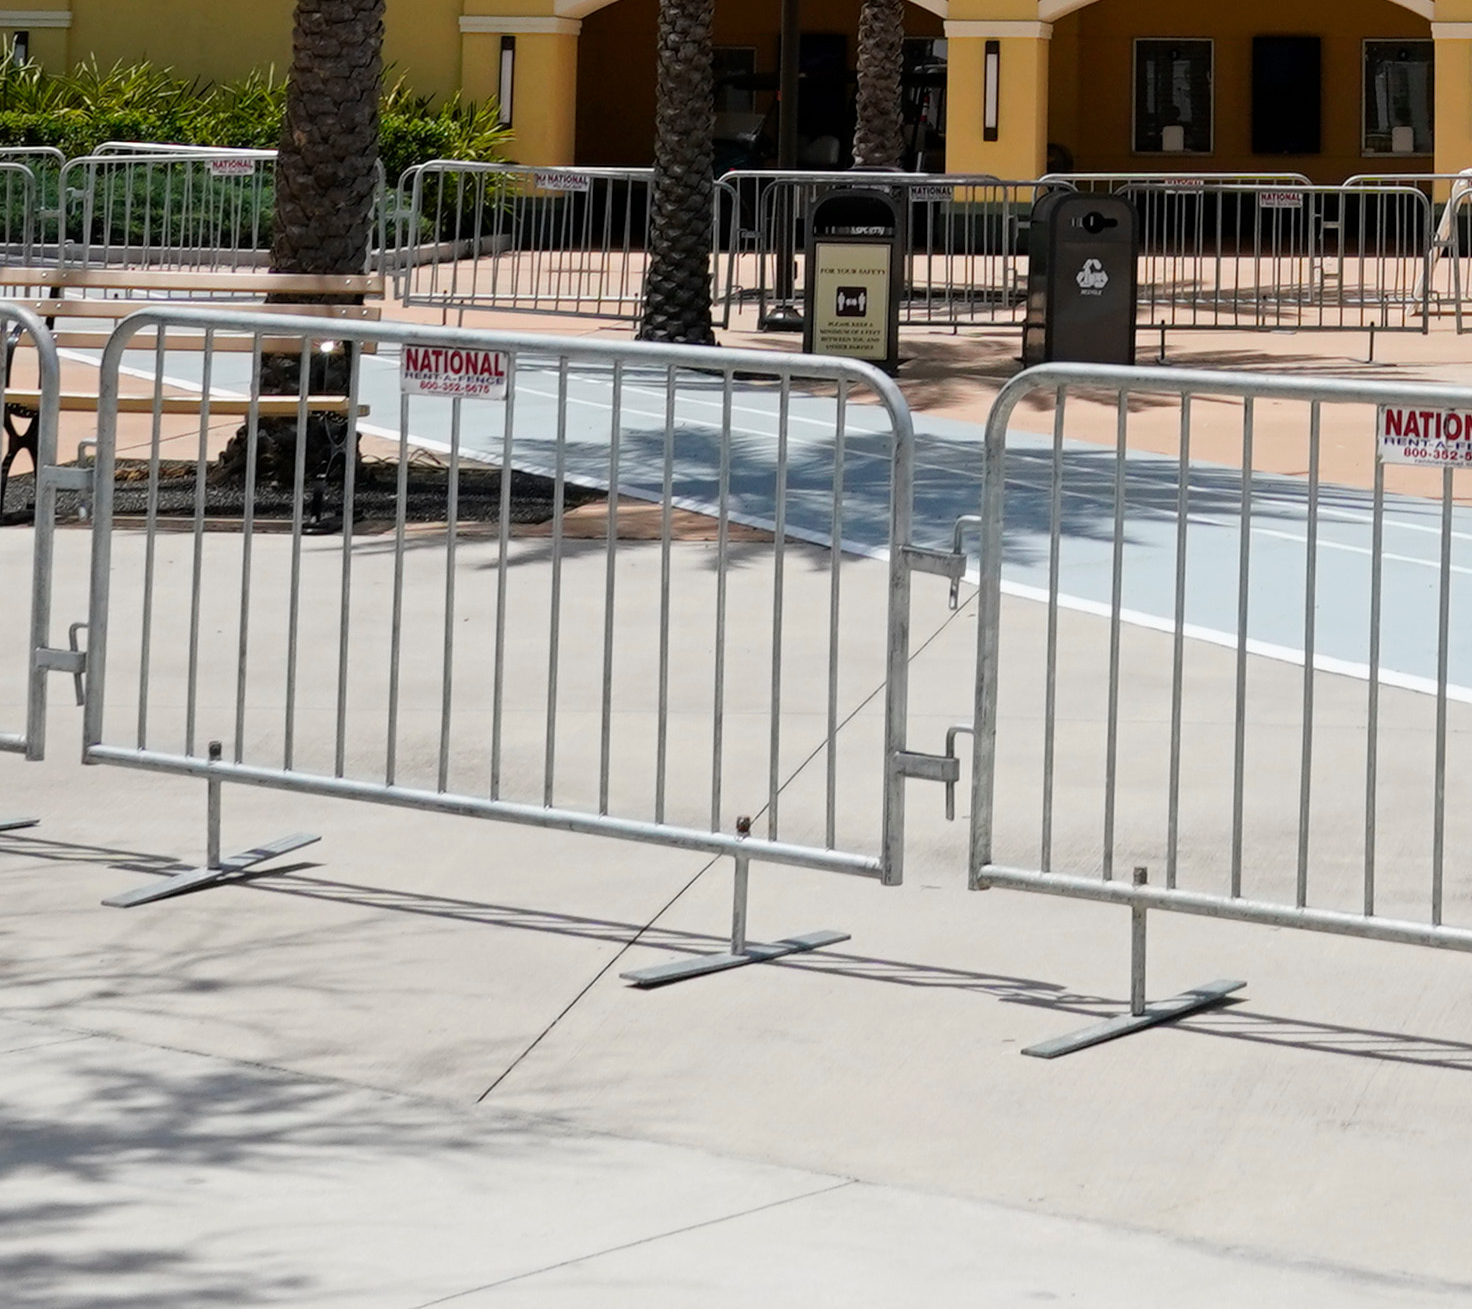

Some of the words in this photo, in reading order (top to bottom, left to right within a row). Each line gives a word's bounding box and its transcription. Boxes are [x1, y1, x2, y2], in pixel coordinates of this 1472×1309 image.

[211, 159, 253, 169] NATIONAL
[548, 173, 588, 185] NATIONAL
[911, 185, 953, 195] NATIONAL
[1260, 192, 1302, 202] NATIONAL
[406, 348, 505, 377] NATIONAL
[404, 371, 504, 385] RENT-A-FENCE
[419, 380, 490, 394] 800-352-5675
